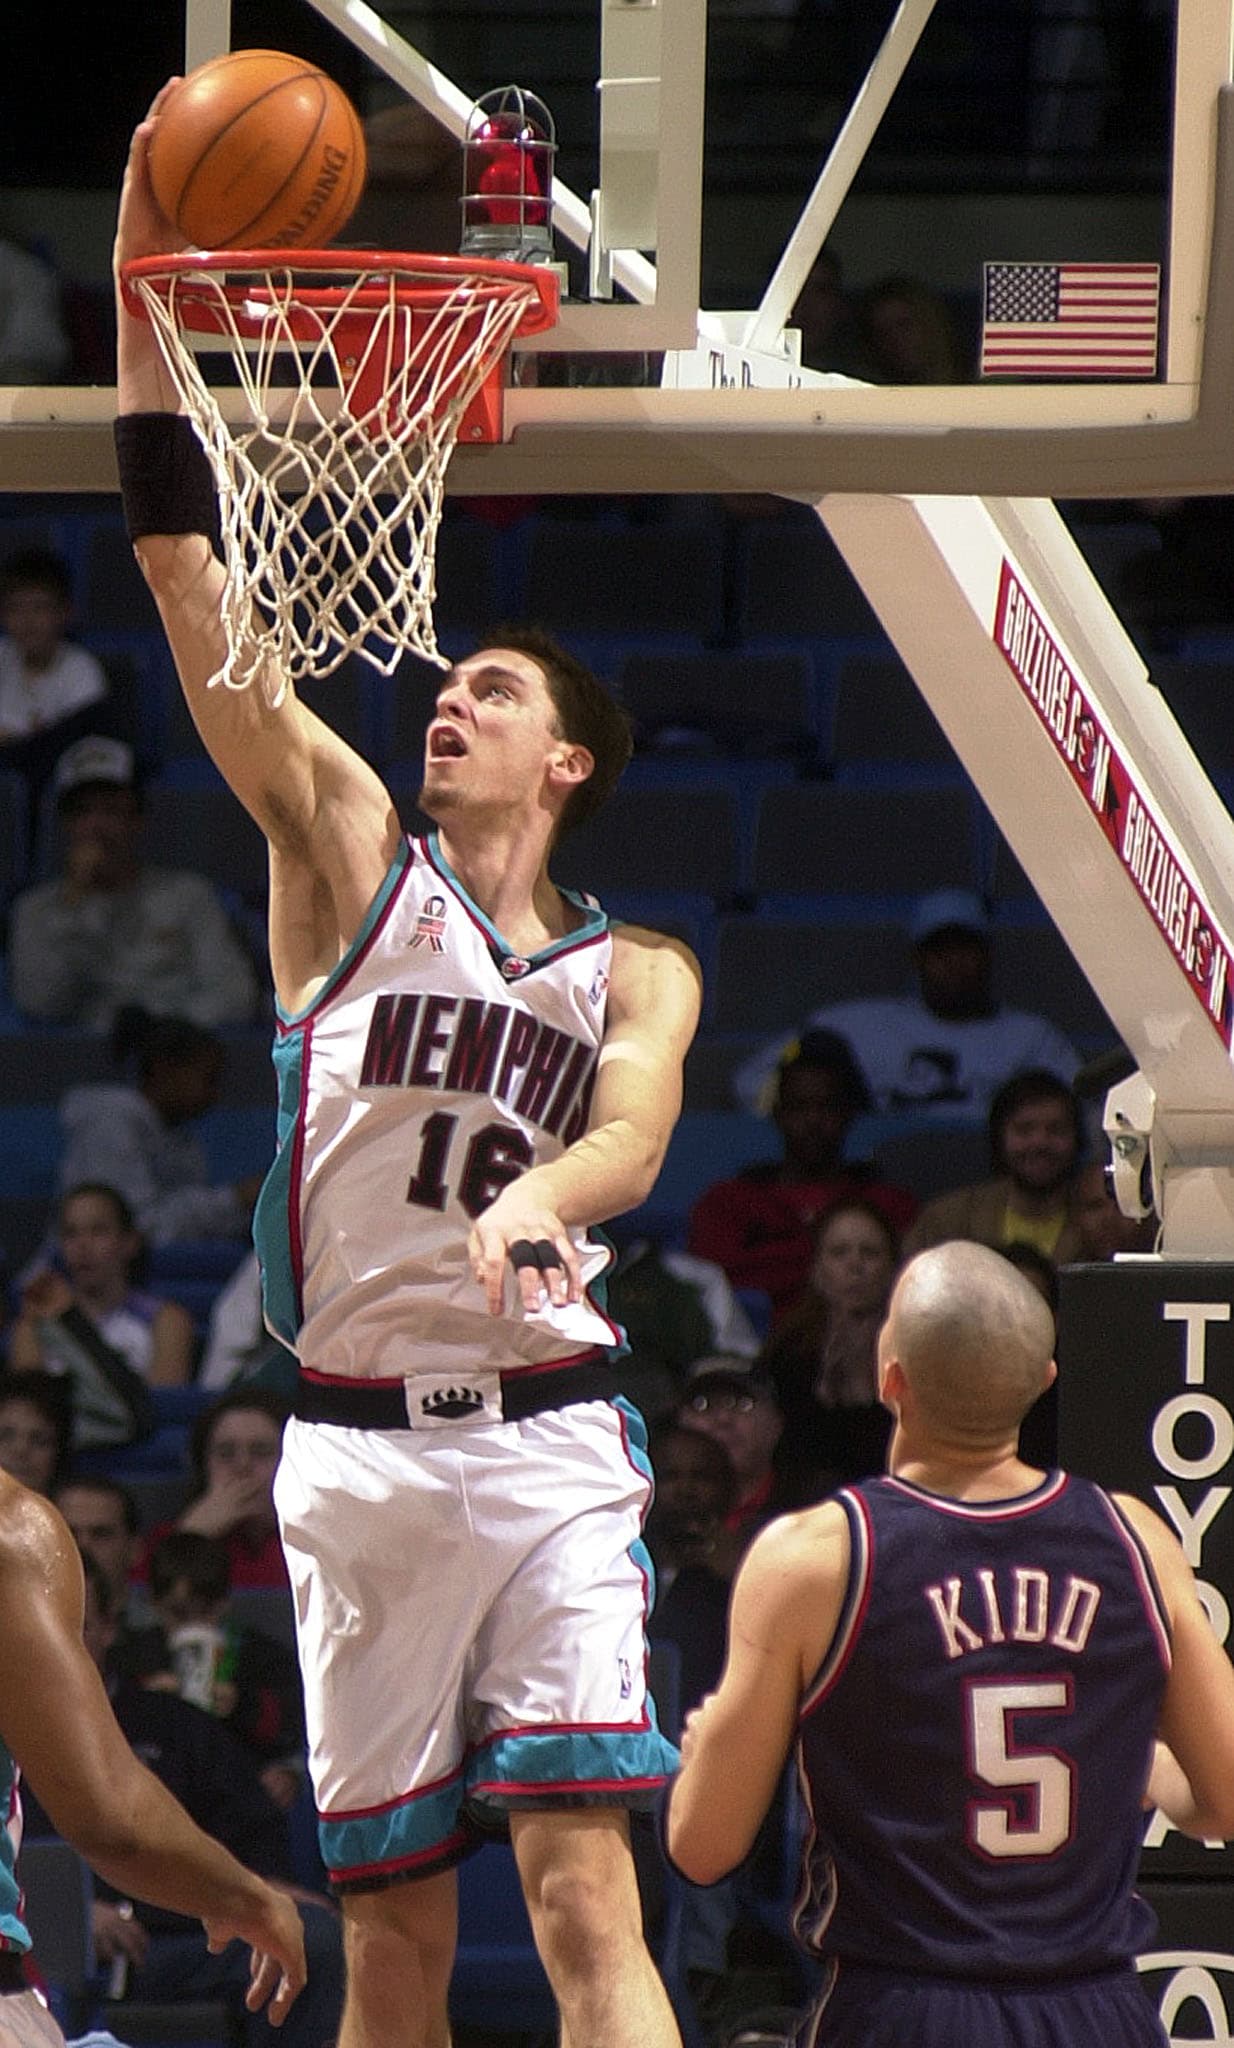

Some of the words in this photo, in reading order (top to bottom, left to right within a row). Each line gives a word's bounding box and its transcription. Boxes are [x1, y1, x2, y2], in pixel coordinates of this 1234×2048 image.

[258, 143, 348, 249] ALDING
[405, 1111, 536, 1220] 16
[925, 1567, 1101, 1658] KIDD
[962, 1674, 1078, 1864] 5
